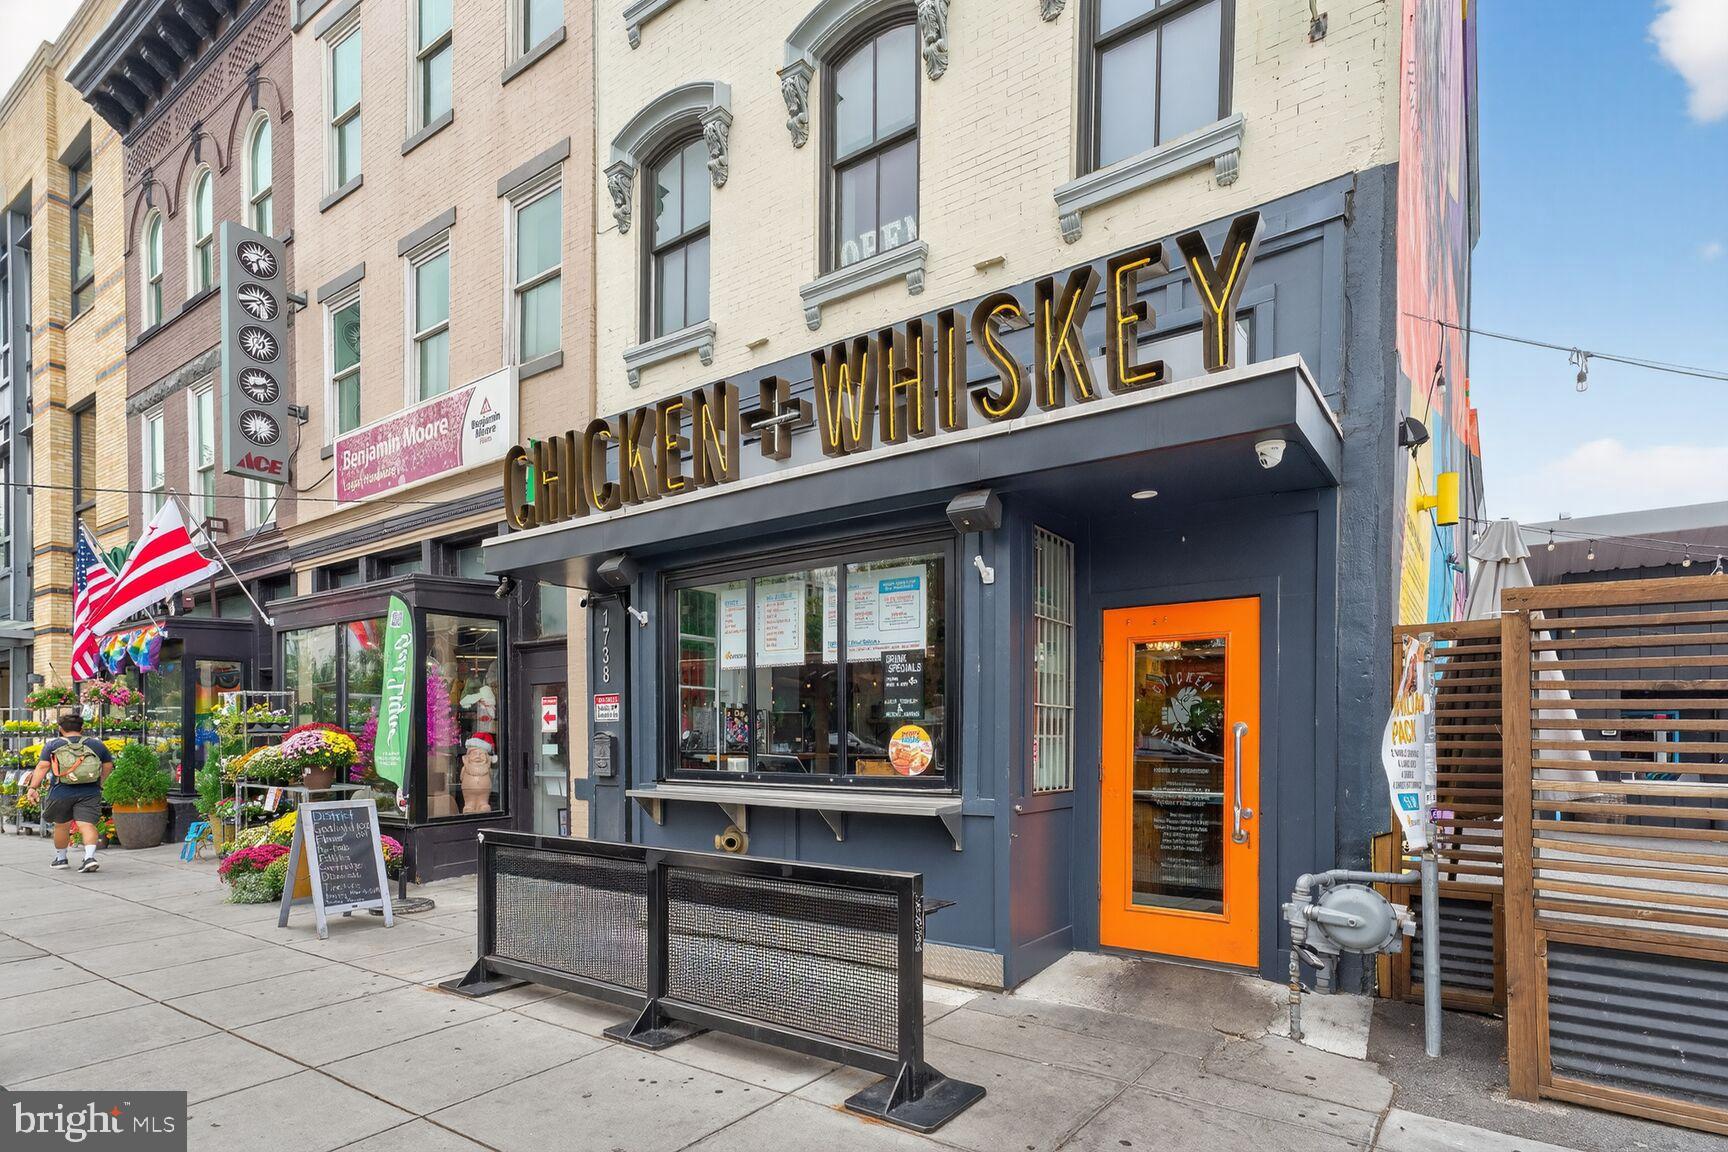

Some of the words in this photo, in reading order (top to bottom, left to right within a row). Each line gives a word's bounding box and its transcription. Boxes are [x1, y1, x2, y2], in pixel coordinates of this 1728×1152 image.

[503, 380, 739, 530] CHICKEN
[811, 211, 1265, 456] WHISKEY
[236, 451, 283, 475] ACE
[342, 432, 400, 471] Benjamin
[402, 416, 449, 450] Moore
[601, 608, 610, 683] 1738
[888, 662, 922, 673] SPECIALS
[312, 809, 353, 822] District
